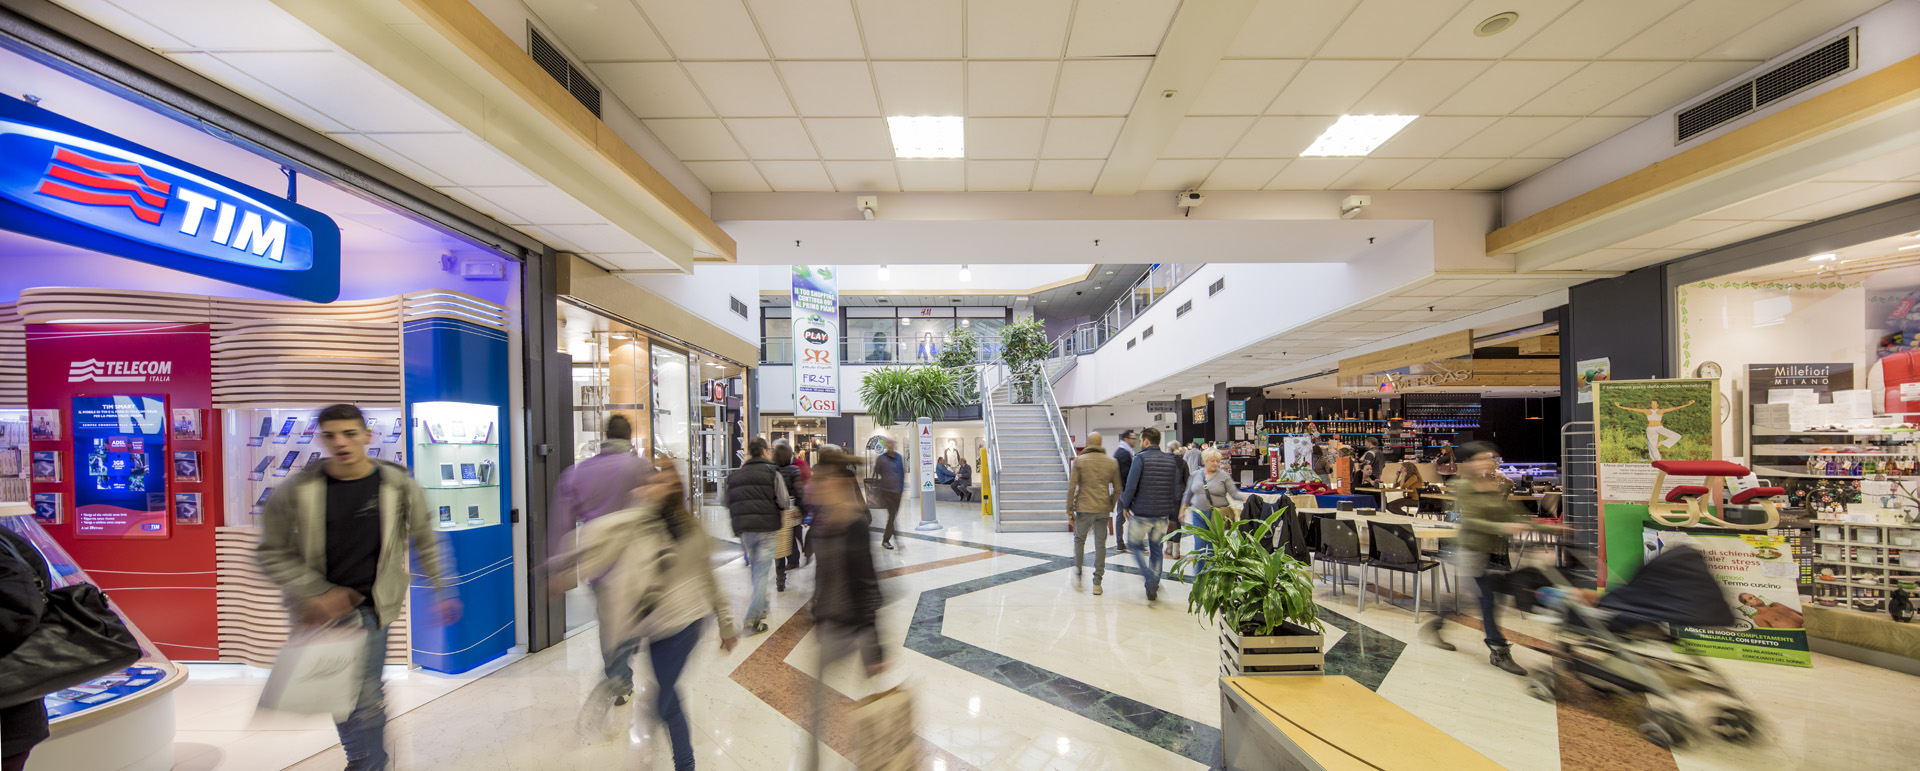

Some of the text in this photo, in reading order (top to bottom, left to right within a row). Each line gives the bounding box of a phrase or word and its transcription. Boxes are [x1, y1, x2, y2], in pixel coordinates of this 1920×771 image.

[177, 187, 287, 263] TIM
[794, 287, 835, 300] IL TUO SHOPPING
[798, 294, 823, 304] CONTINUA
[802, 302, 820, 310] PRIMO
[820, 304, 835, 314] PIANO
[805, 331, 827, 340] PLAY
[106, 361, 172, 374] TELECOM
[1775, 365, 1829, 376] Millefiori
[803, 374, 831, 385] FIRST
[813, 400, 836, 410] GSI
[1736, 632, 1794, 642] COMPLETAMENTE
